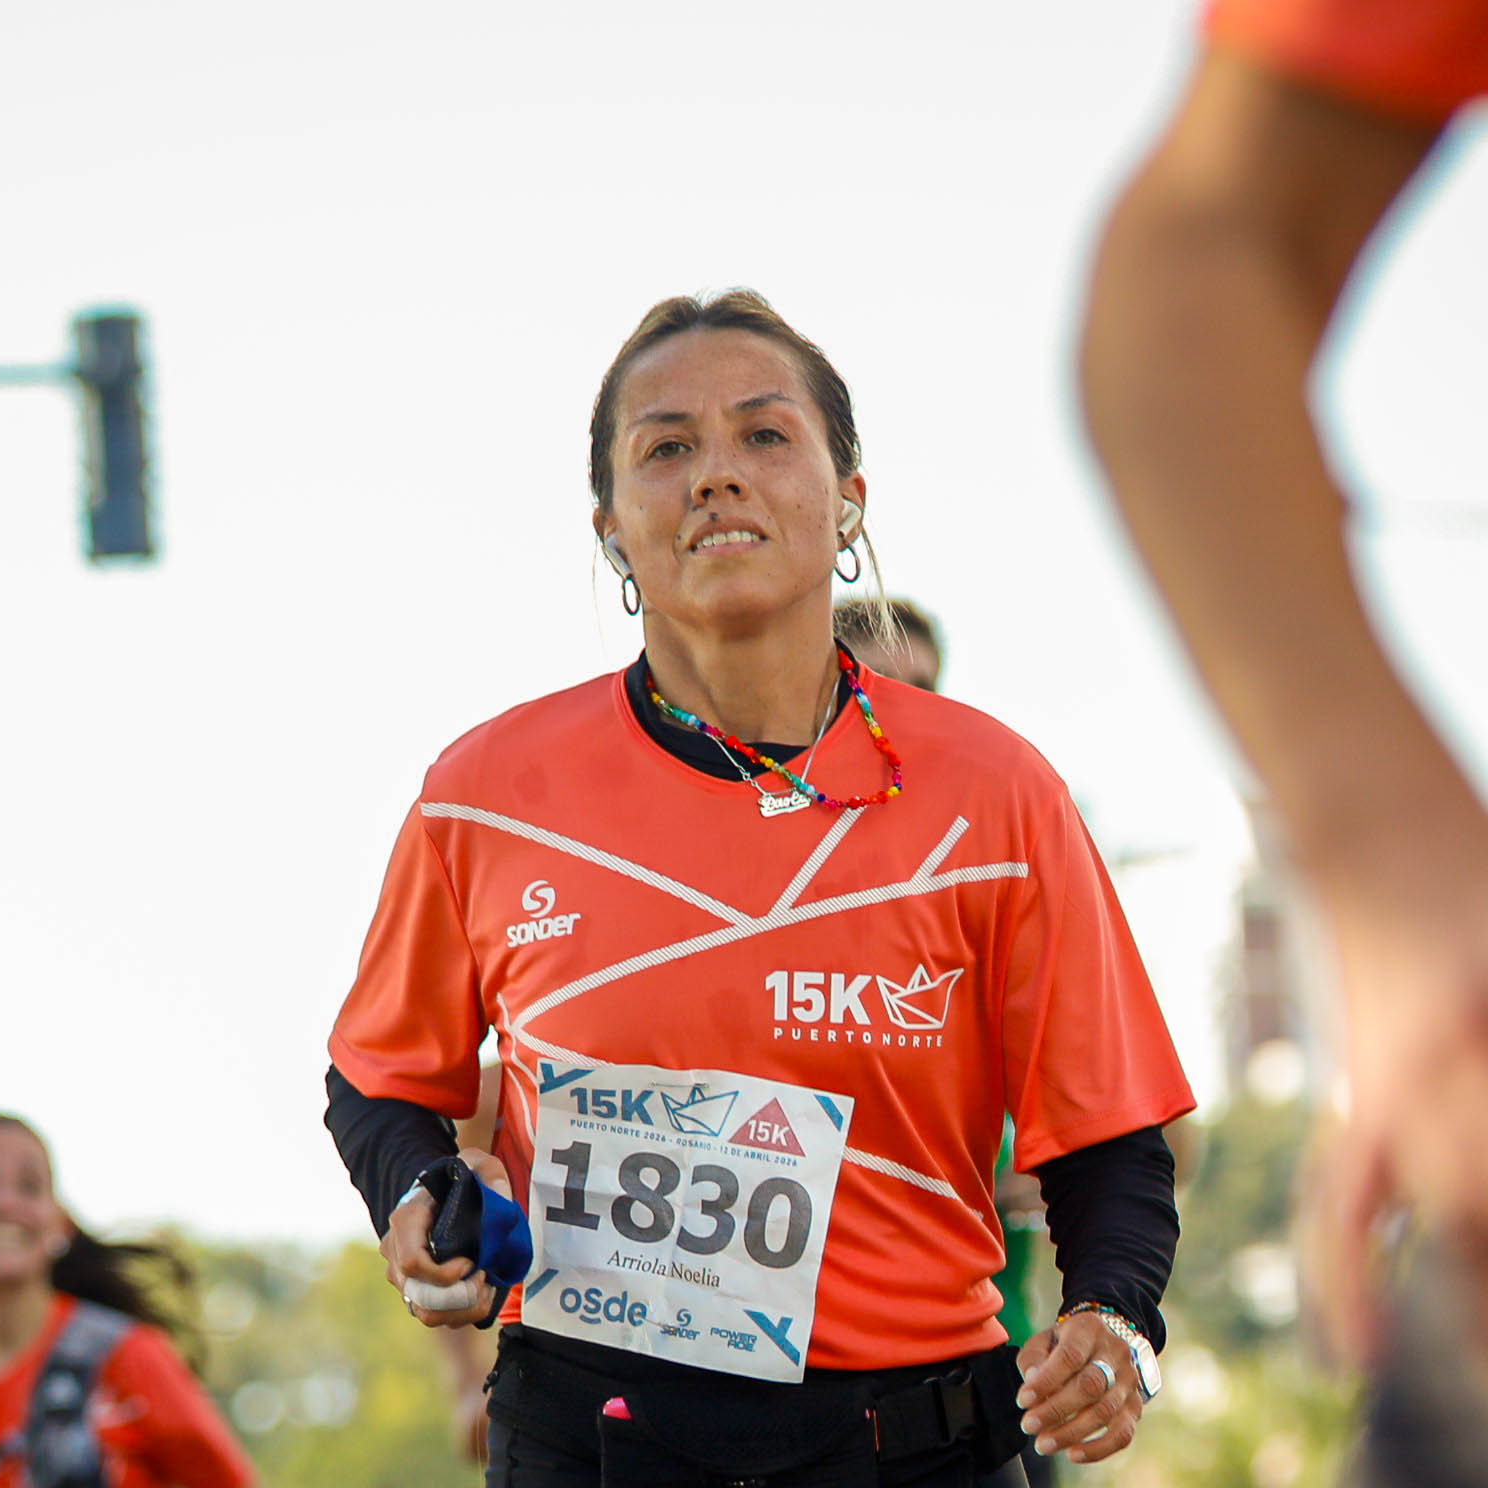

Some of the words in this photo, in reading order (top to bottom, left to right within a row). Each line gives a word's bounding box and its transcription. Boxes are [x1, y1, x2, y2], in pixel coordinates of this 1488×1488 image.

[764, 970, 873, 1026] 15K
[773, 1027, 872, 1044] PUERTO
[882, 1033, 943, 1048] NORTE
[570, 1087, 654, 1126] 15K
[570, 1119, 607, 1132] PUERTO
[610, 1125, 640, 1138] NORTE
[644, 1131, 666, 1143] 2026
[676, 1137, 711, 1151] ROSARIO
[731, 1148, 741, 1157] DE
[744, 1150, 770, 1163] ABRIL
[747, 1119, 790, 1147] 15K
[545, 1140, 813, 1269] 1830
[607, 1249, 667, 1276] Arriola
[671, 1261, 720, 1288] Noelia
[559, 1287, 647, 1327] osde
